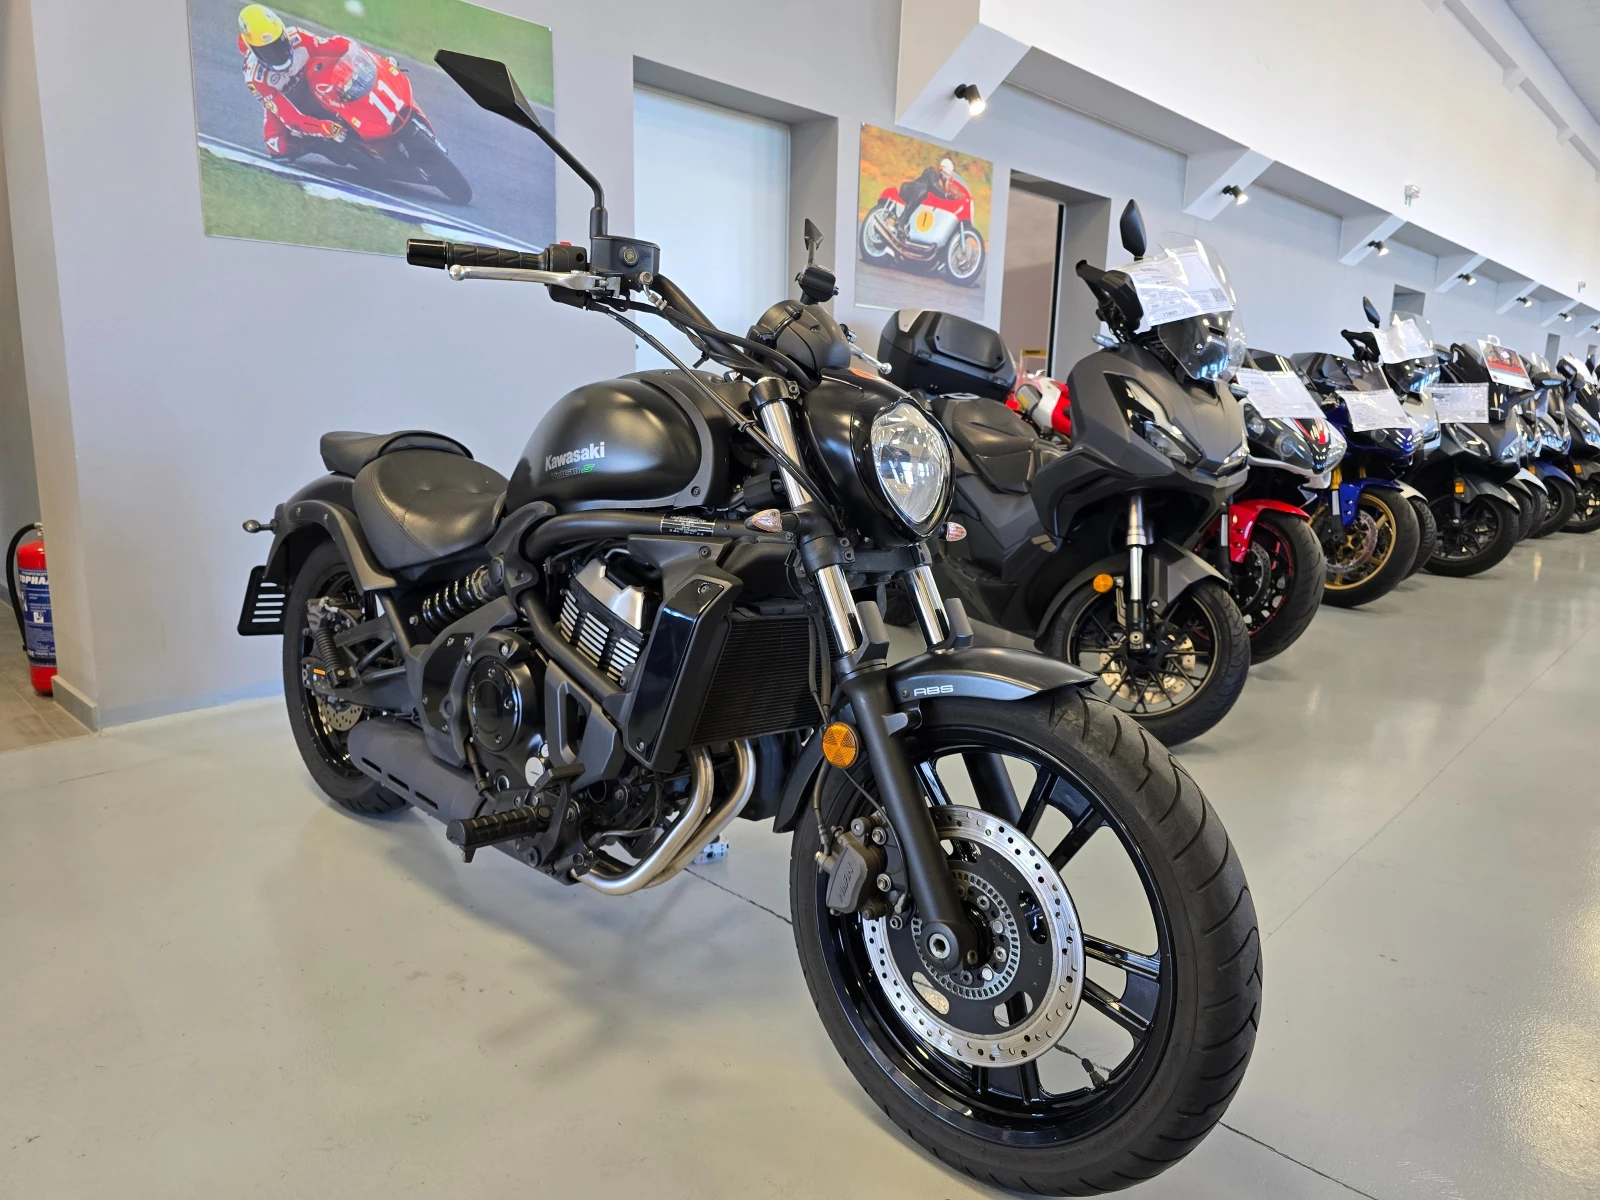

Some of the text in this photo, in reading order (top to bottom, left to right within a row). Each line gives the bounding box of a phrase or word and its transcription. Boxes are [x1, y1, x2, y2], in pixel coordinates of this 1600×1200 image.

[369, 79, 405, 126] 11
[545, 441, 605, 472] Kawasaki
[913, 684, 954, 697] ABS
